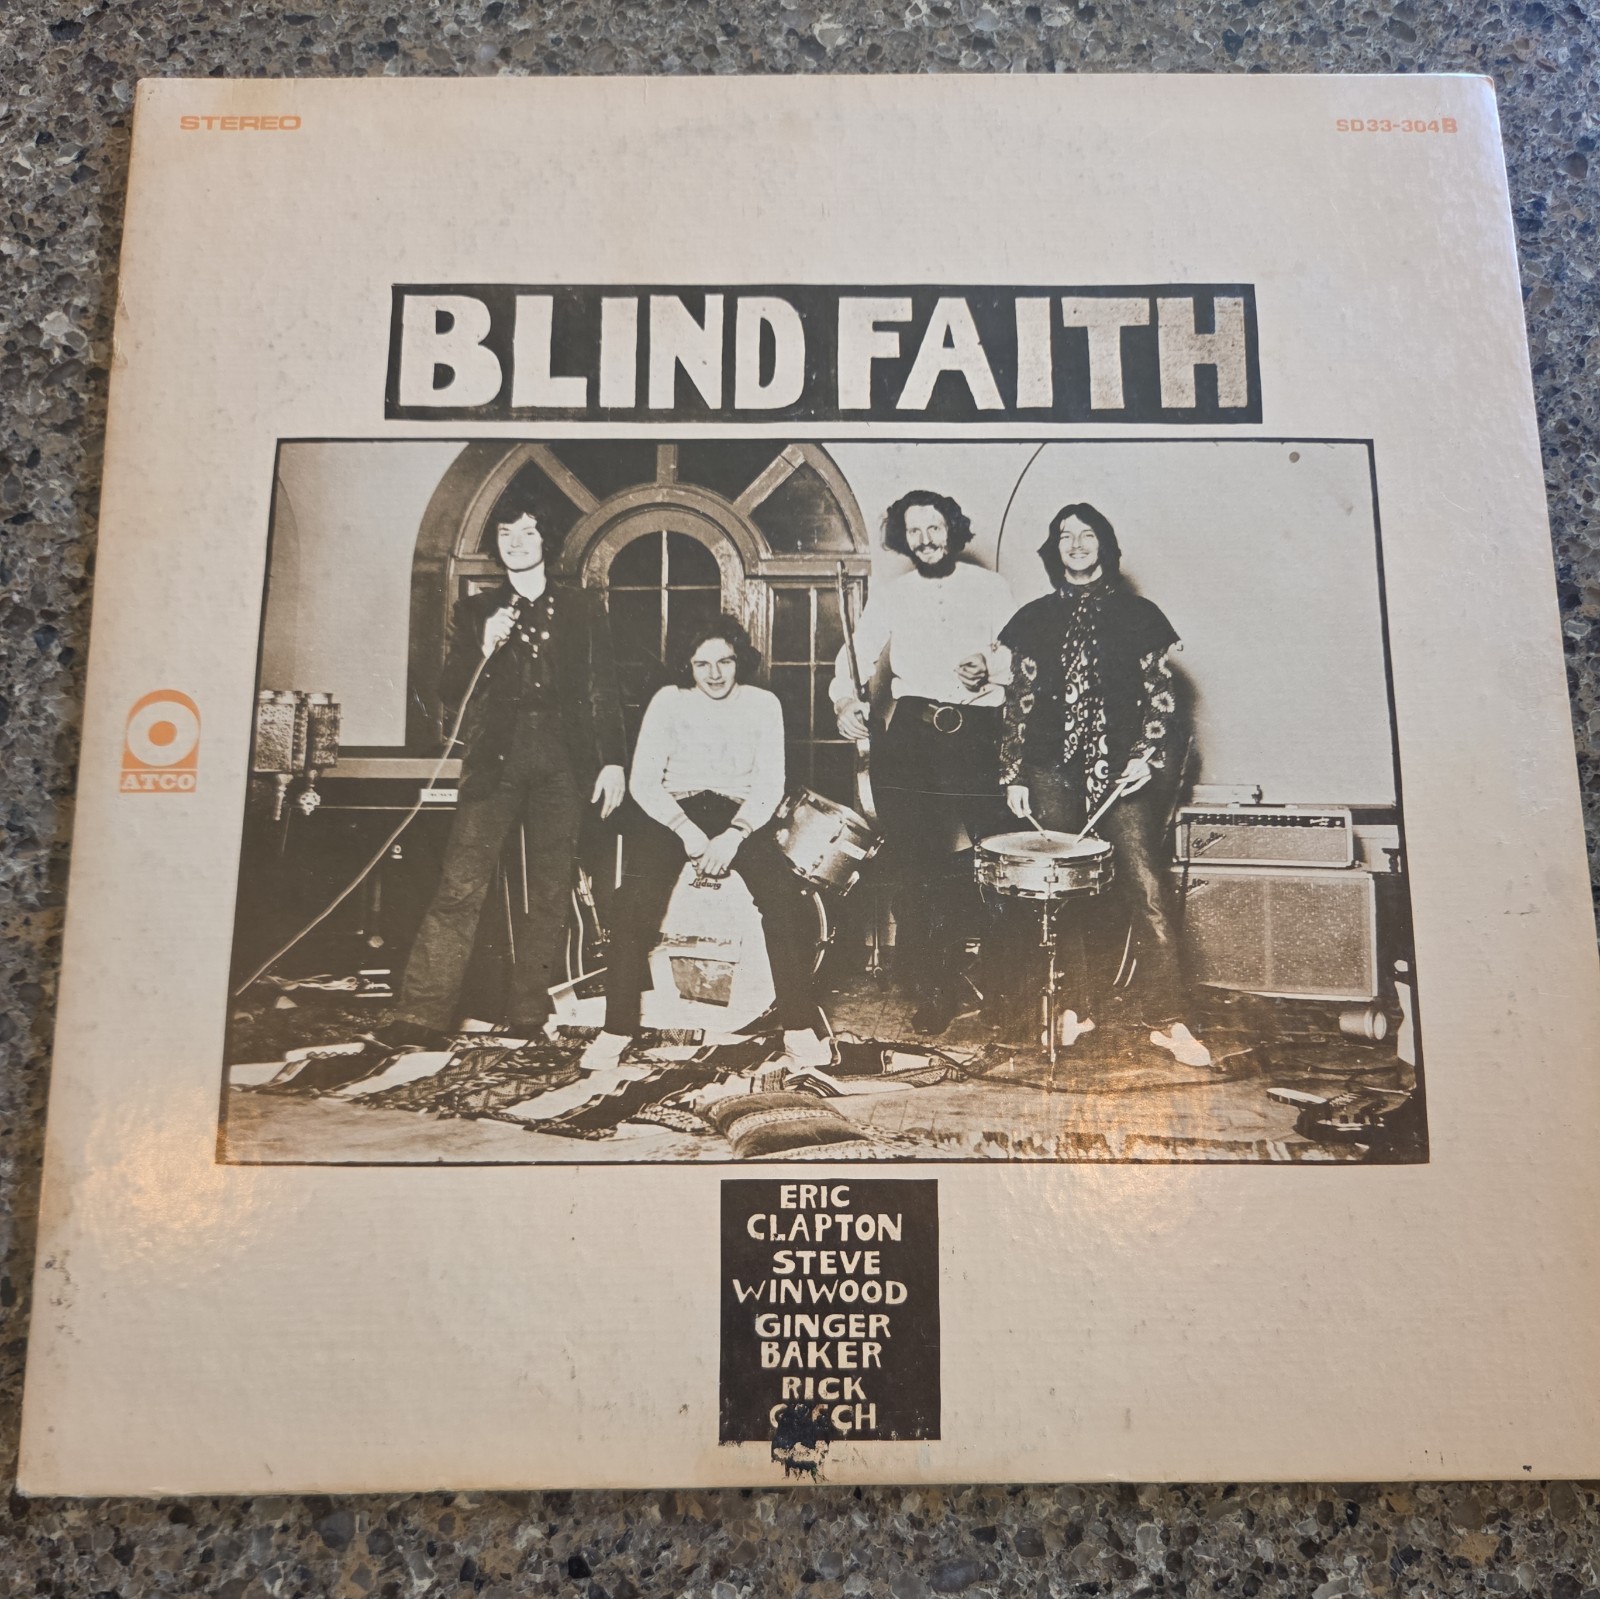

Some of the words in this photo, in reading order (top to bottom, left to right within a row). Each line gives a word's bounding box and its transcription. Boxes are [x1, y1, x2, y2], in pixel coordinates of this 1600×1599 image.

[180, 116, 301, 130] STEREO
[399, 294, 806, 409] BLIND
[837, 296, 1248, 410] FAITH
[121, 773, 196, 790] ATCO
[688, 878, 721, 890] Ludwig
[780, 1184, 850, 1209] ERIC
[747, 1213, 902, 1242] CLAPTON
[772, 1250, 880, 1275] STEVE
[732, 1279, 908, 1305] WINWOOD
[755, 1313, 891, 1338] GINGER
[761, 1341, 882, 1369] BAKER
[782, 1376, 867, 1400] RICK
